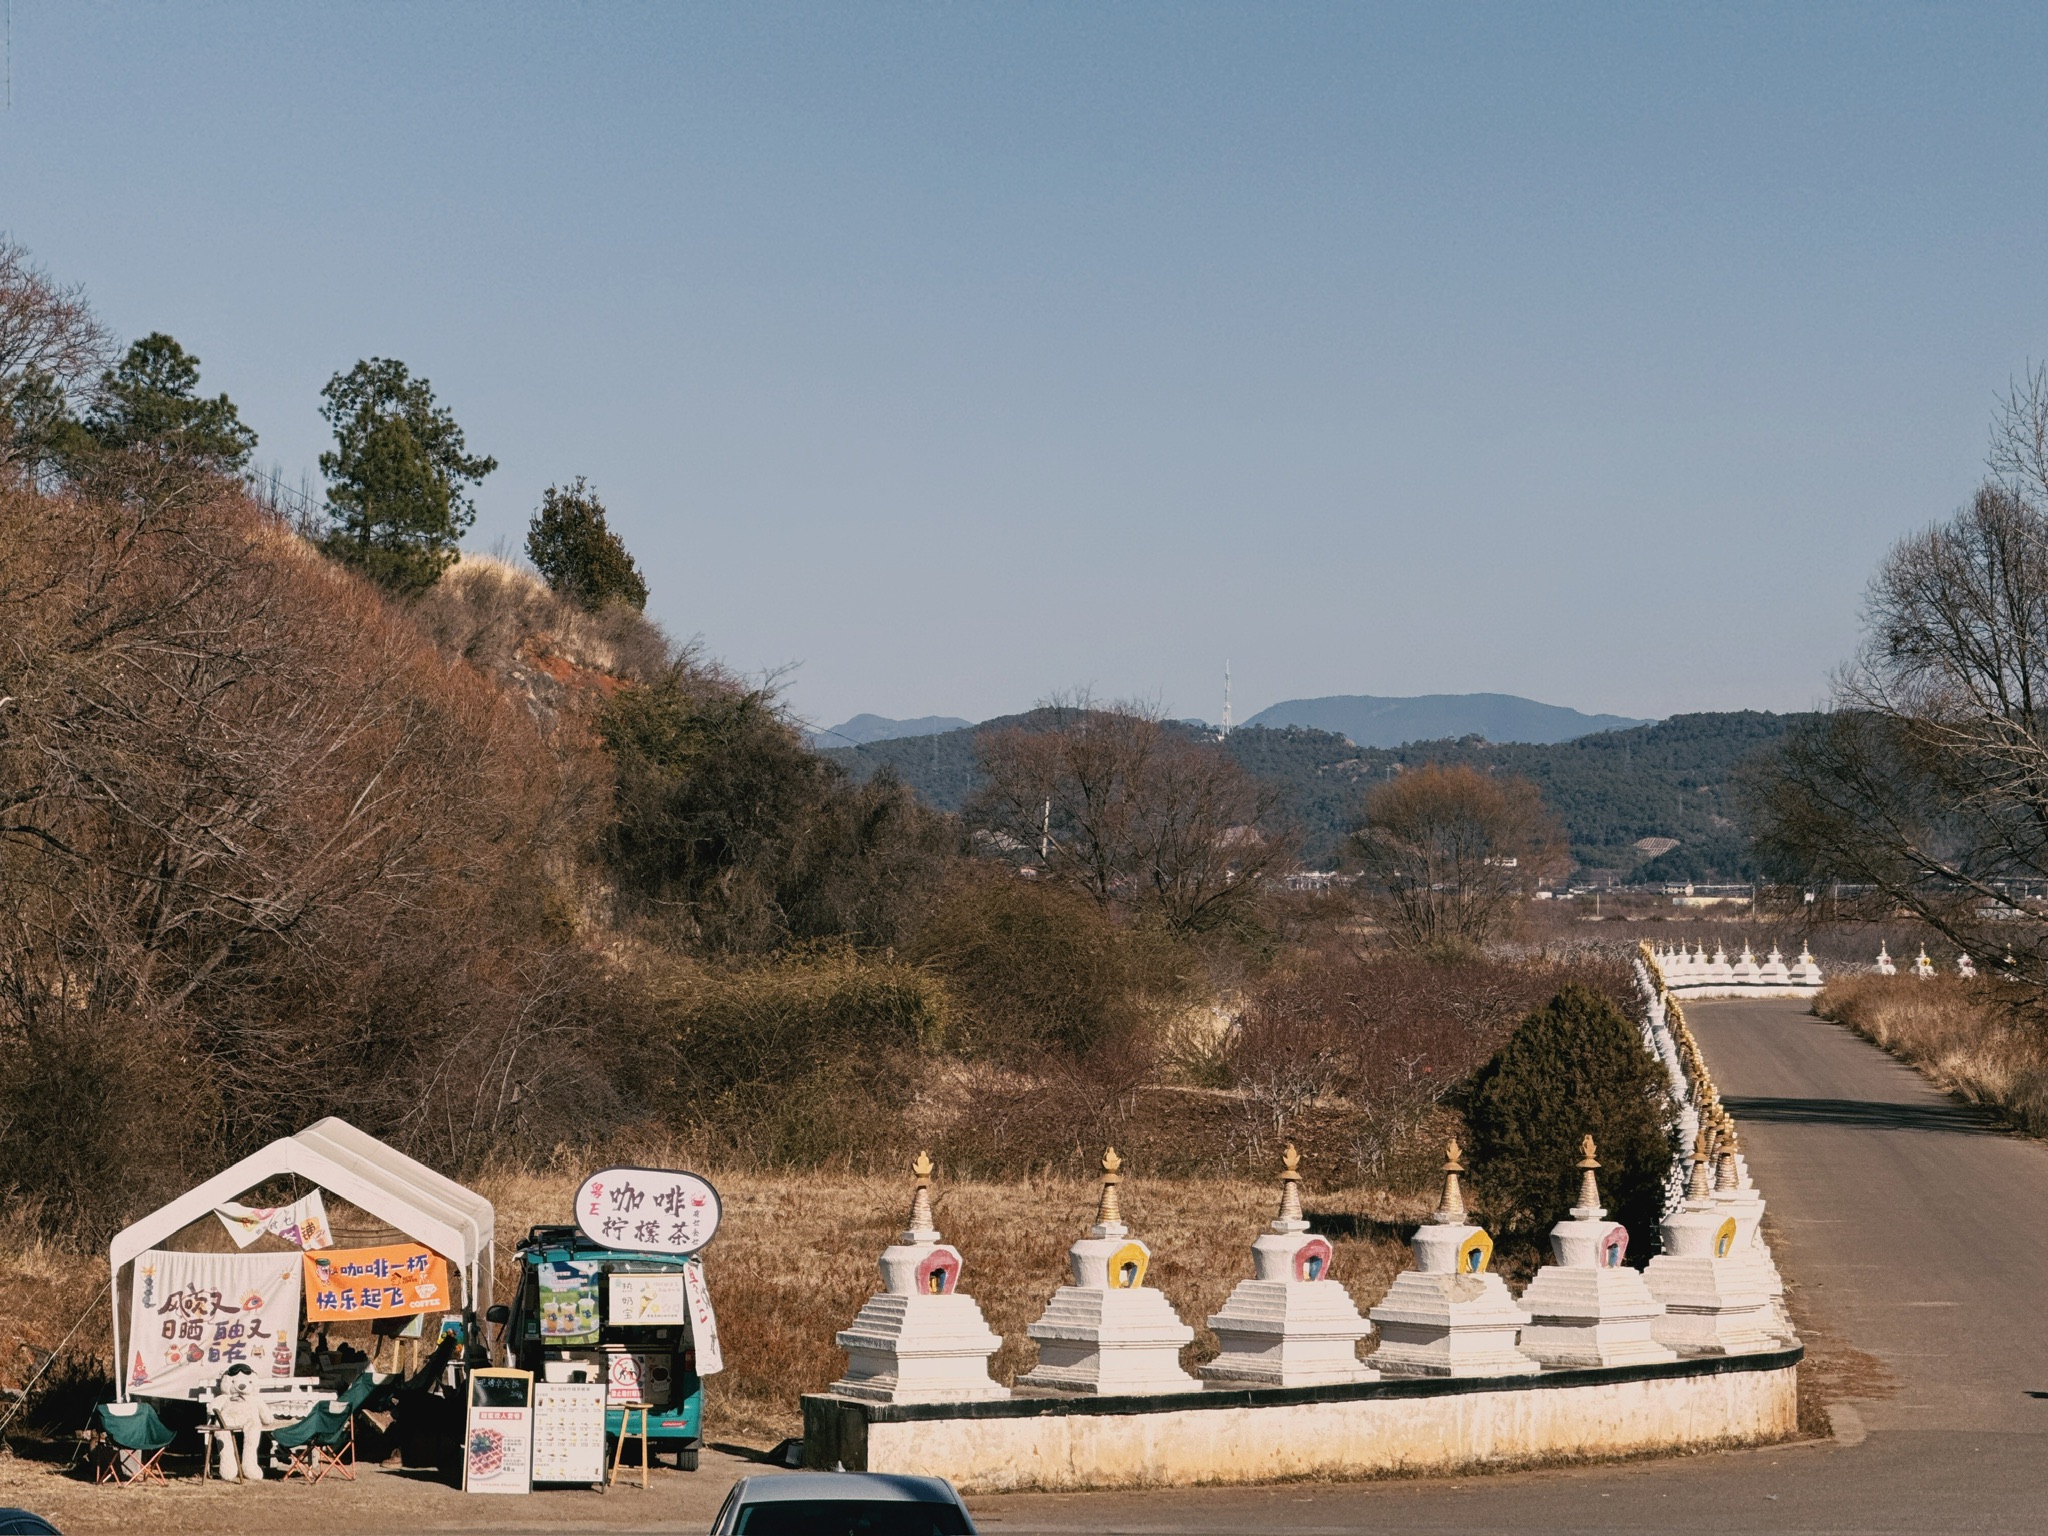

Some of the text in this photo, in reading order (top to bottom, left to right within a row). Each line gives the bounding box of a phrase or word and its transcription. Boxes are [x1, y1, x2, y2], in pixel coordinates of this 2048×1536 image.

[609, 1181, 686, 1218] 咖啡
[602, 1216, 690, 1246] 柠檬茶
[340, 1254, 429, 1278] 咖啡一杯
[157, 1282, 241, 1318] 风吹又
[316, 1286, 405, 1311] 快乐起飞
[409, 1298, 440, 1309] COFFEE
[161, 1318, 204, 1341] 日晒
[207, 1340, 247, 1364] 自在
